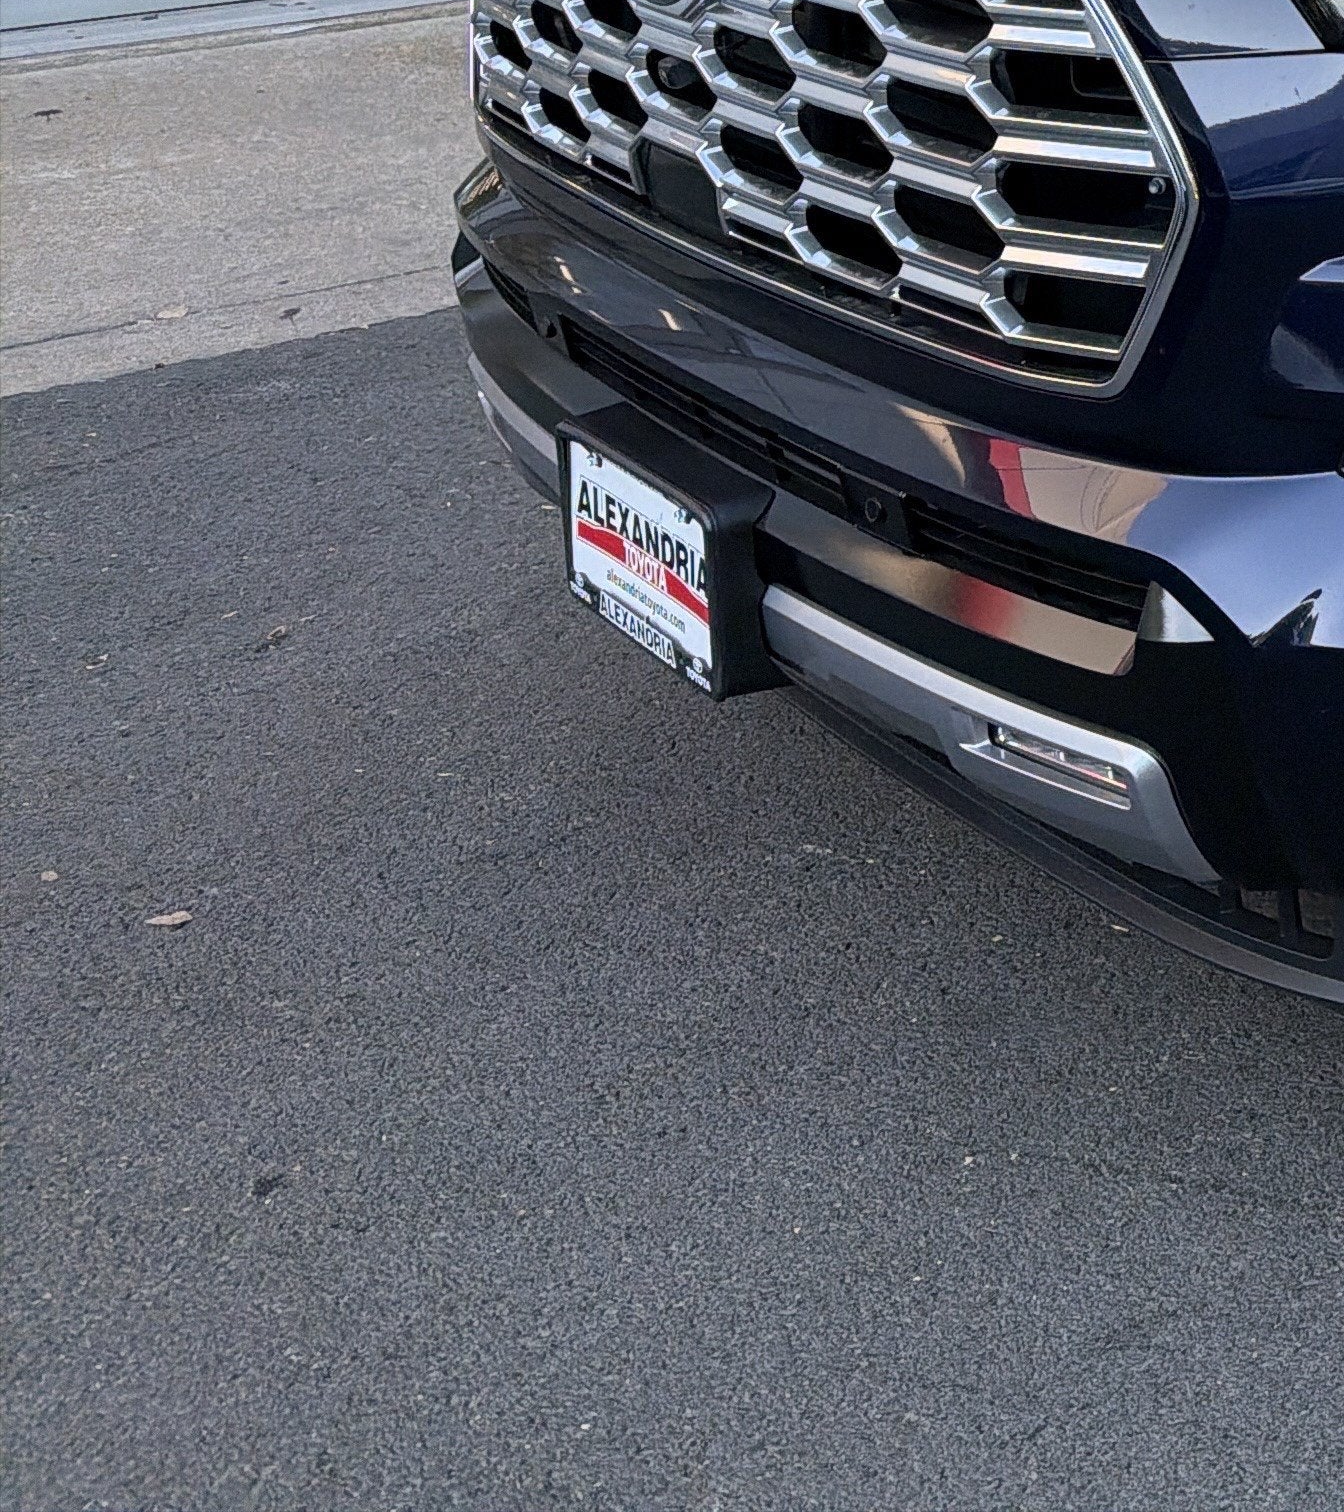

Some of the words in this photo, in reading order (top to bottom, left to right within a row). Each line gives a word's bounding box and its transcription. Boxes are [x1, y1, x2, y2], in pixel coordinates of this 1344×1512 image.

[577, 479, 708, 593] ALEXANDRIA
[623, 539, 668, 594] TOYOTA
[600, 593, 676, 668] ALEXANDRIA
[606, 568, 686, 634] alexandriatoyota.com
[685, 665, 711, 693] TOYOTA
